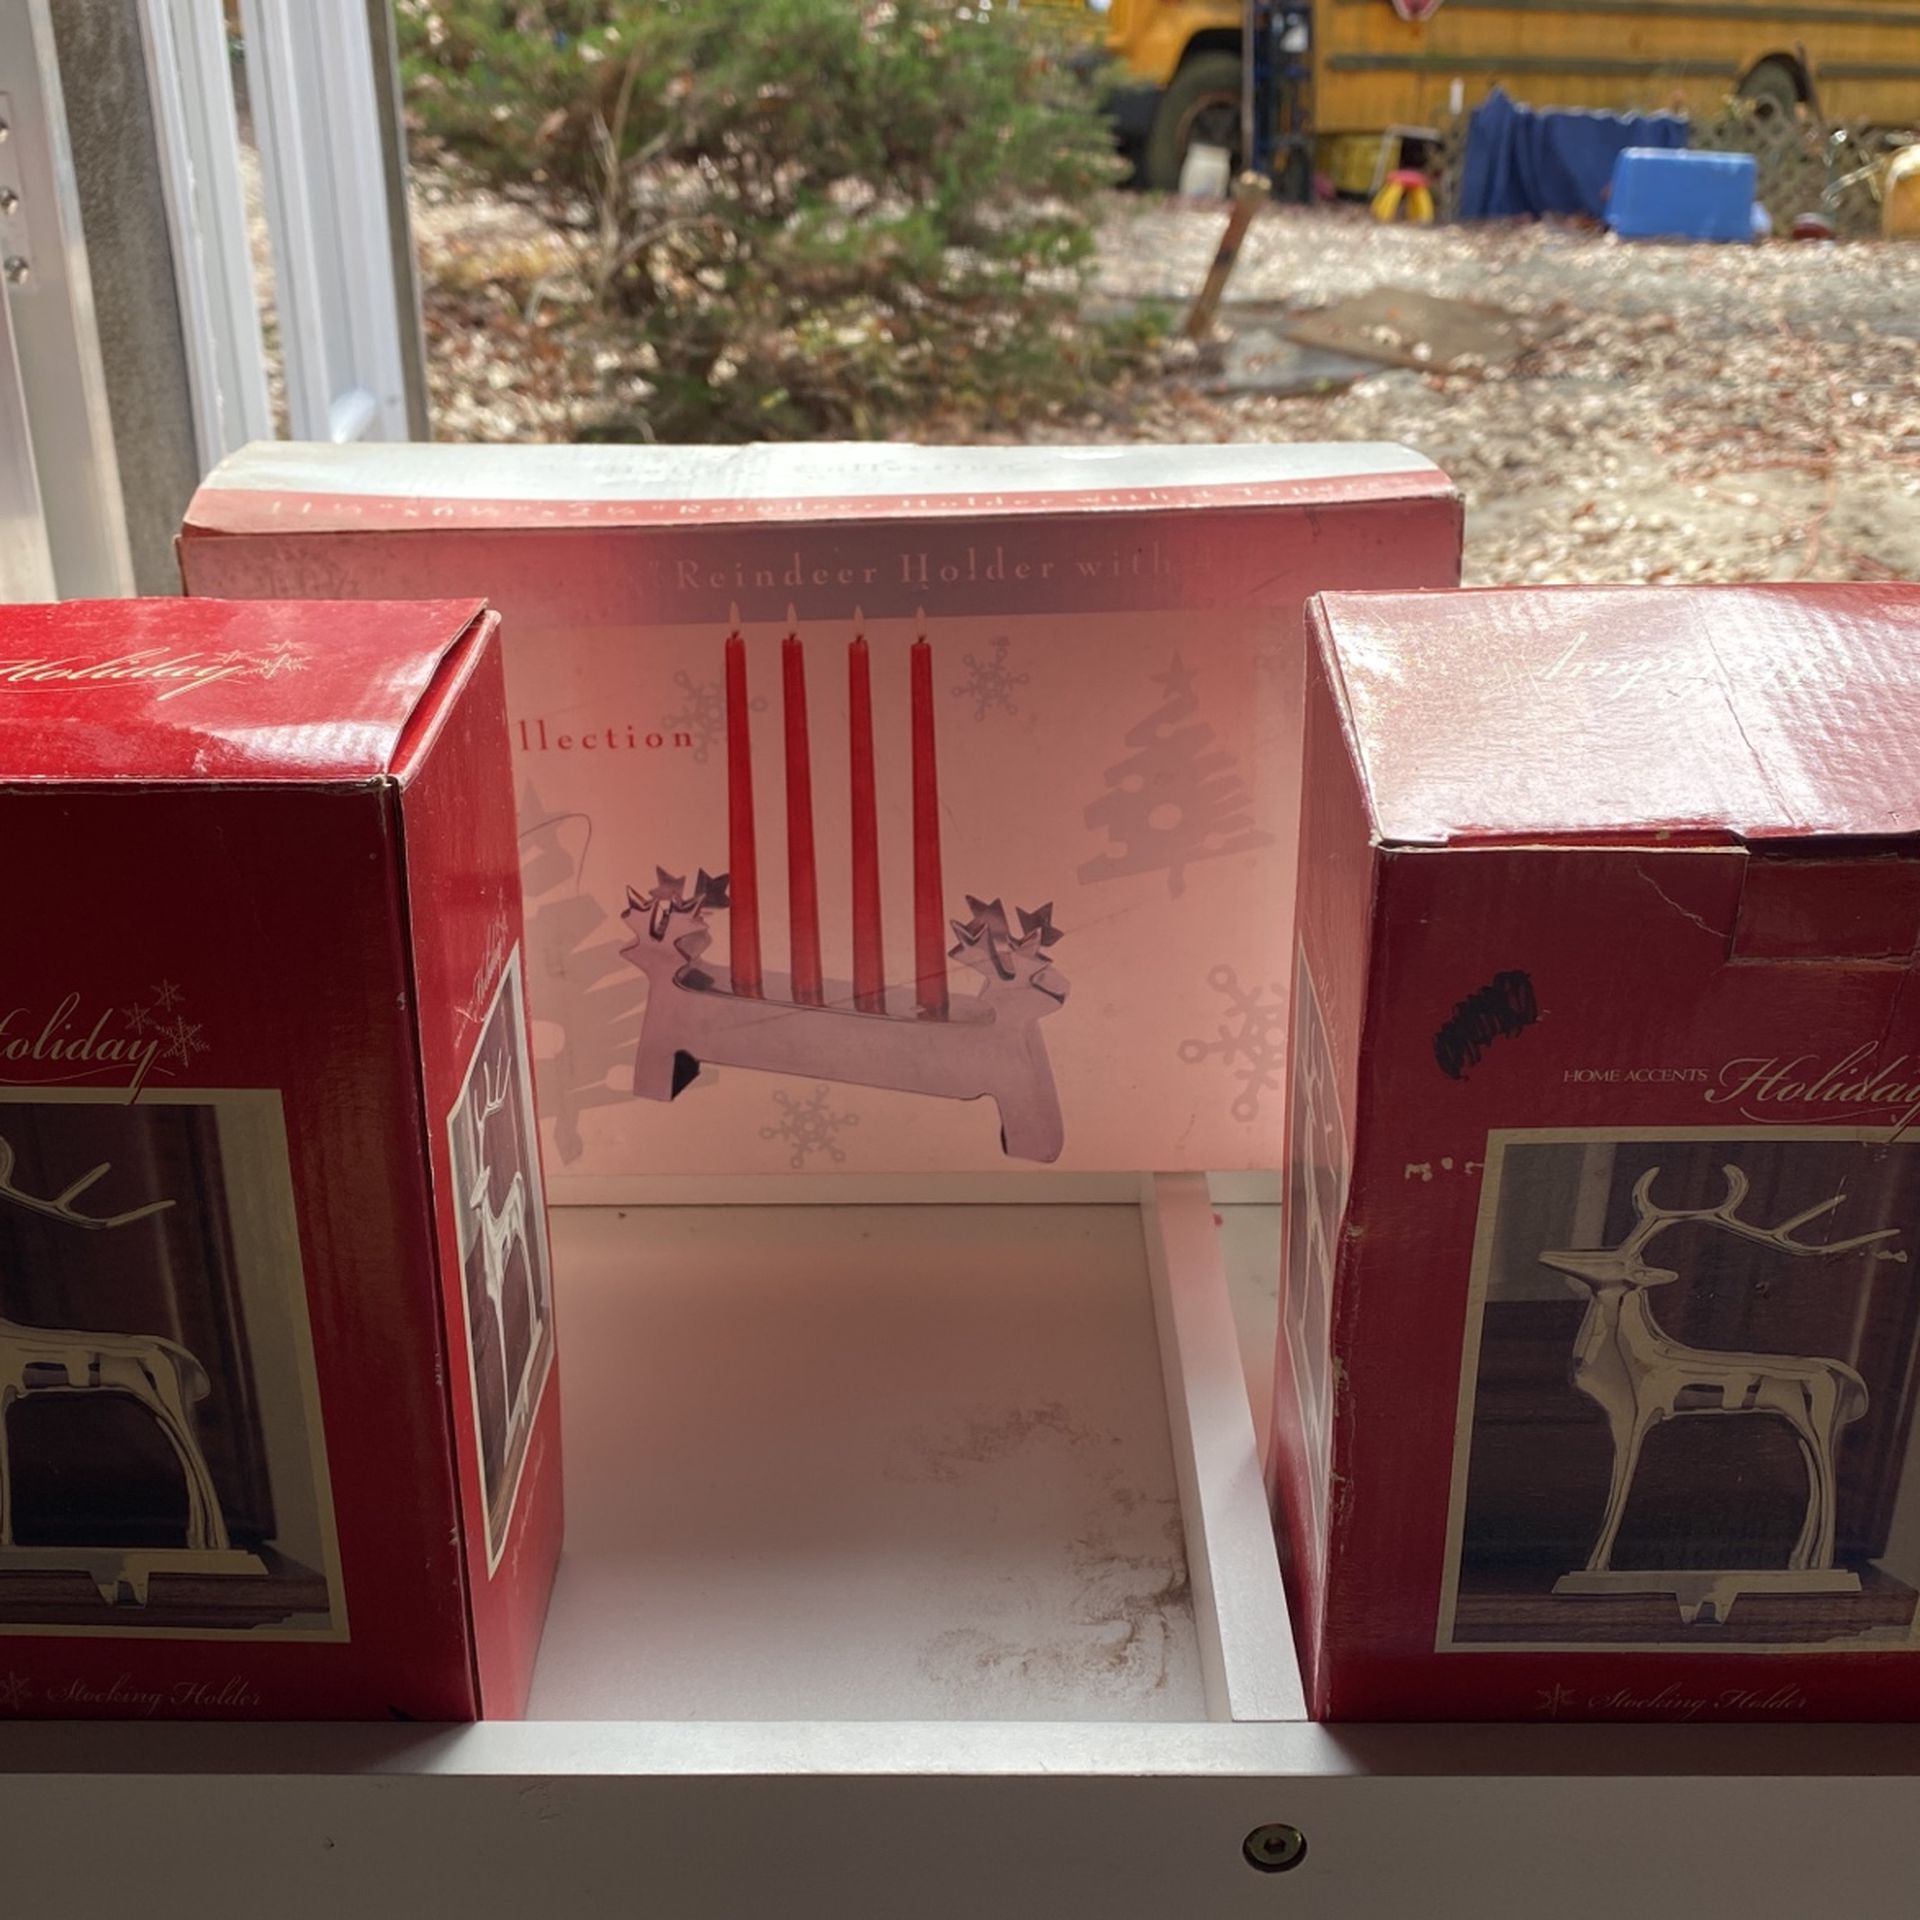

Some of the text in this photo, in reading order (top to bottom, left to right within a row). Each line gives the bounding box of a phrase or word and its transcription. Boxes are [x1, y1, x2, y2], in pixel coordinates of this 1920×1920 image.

[901, 496, 1056, 509] Holder
[1074, 490, 1169, 504] with
[674, 552, 880, 590] Reindeer
[899, 547, 1056, 585] Holder
[1074, 541, 1171, 579] with
[518, 718, 694, 752] llection
[1562, 1070, 1622, 1083] HOME
[1624, 1068, 1708, 1083] ACCENTS
[46, 1671, 264, 1718] Stocking Holder
[1586, 1681, 1808, 1722] Stocking Holder
